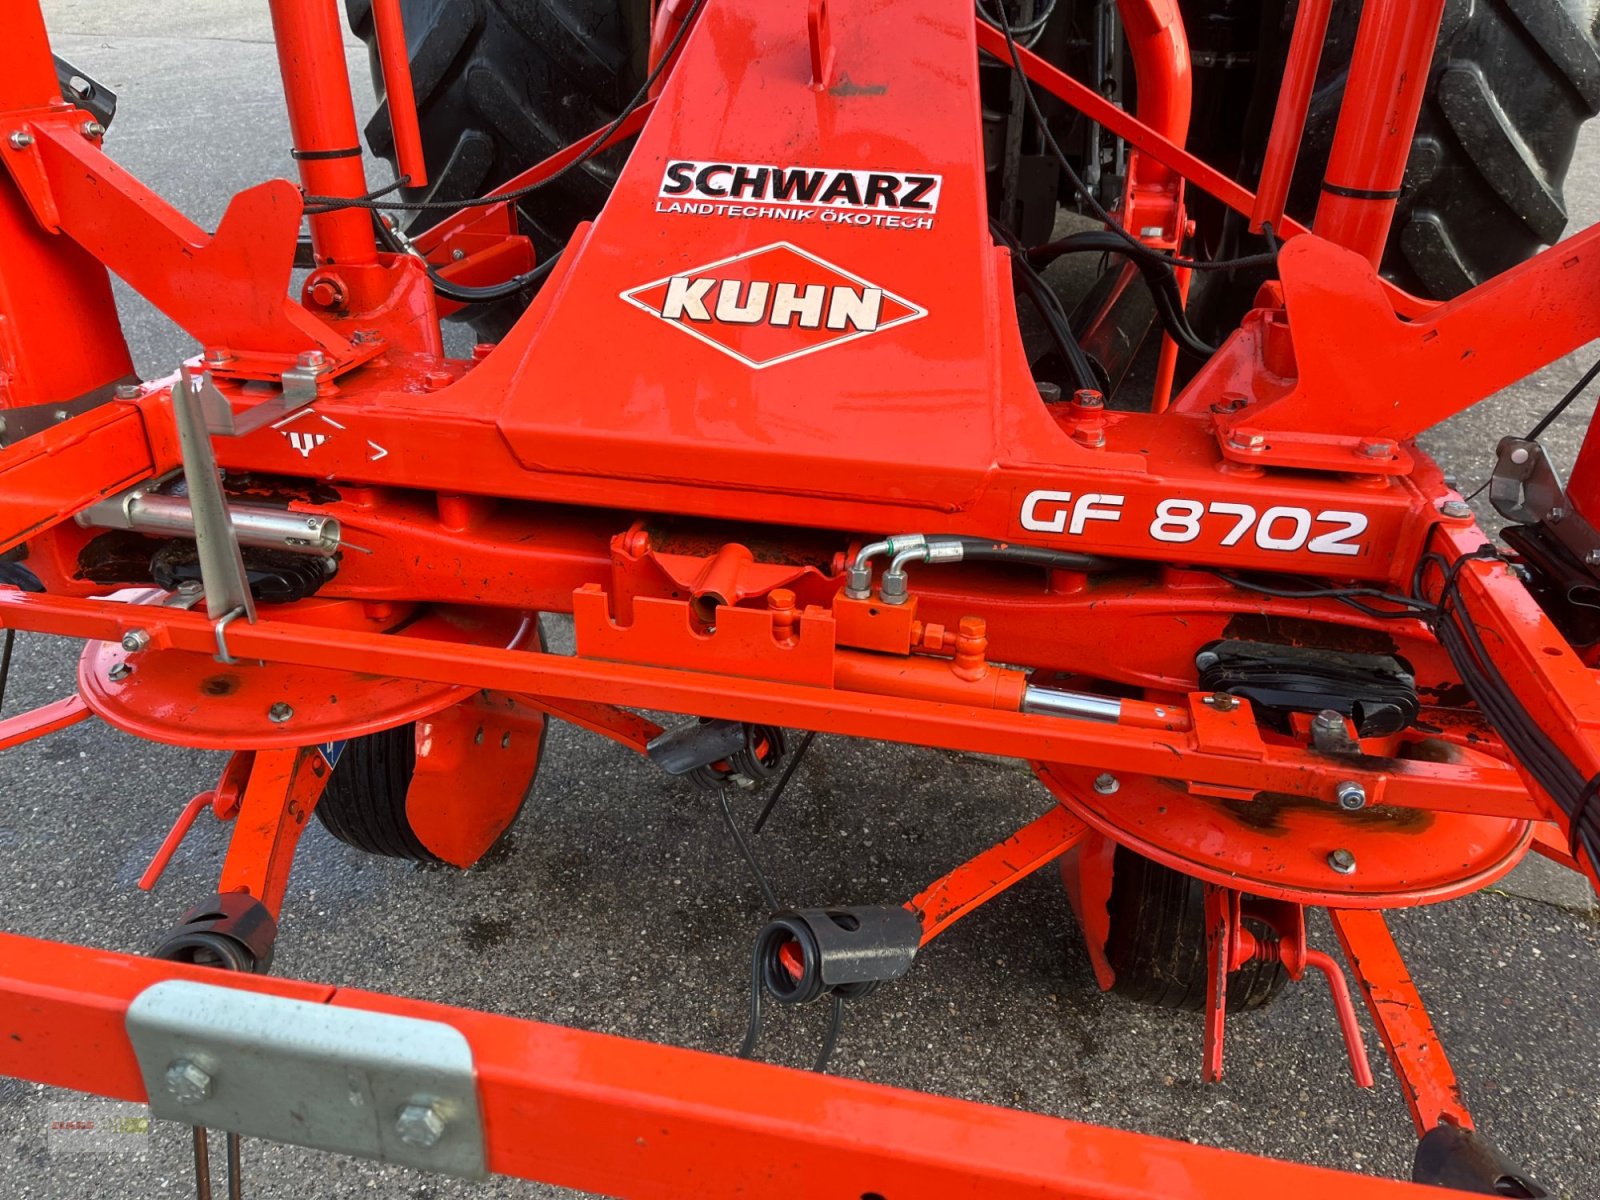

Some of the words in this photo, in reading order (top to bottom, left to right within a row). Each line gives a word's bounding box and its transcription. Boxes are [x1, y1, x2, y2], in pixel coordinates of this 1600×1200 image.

[662, 162, 936, 208] SCHWARZ
[655, 202, 812, 220] LANDTECHNIK
[820, 209, 933, 230] ÖKOTECH
[661, 276, 882, 331] KUHN
[1020, 489, 1125, 535] GF
[1149, 498, 1369, 556] 8702
